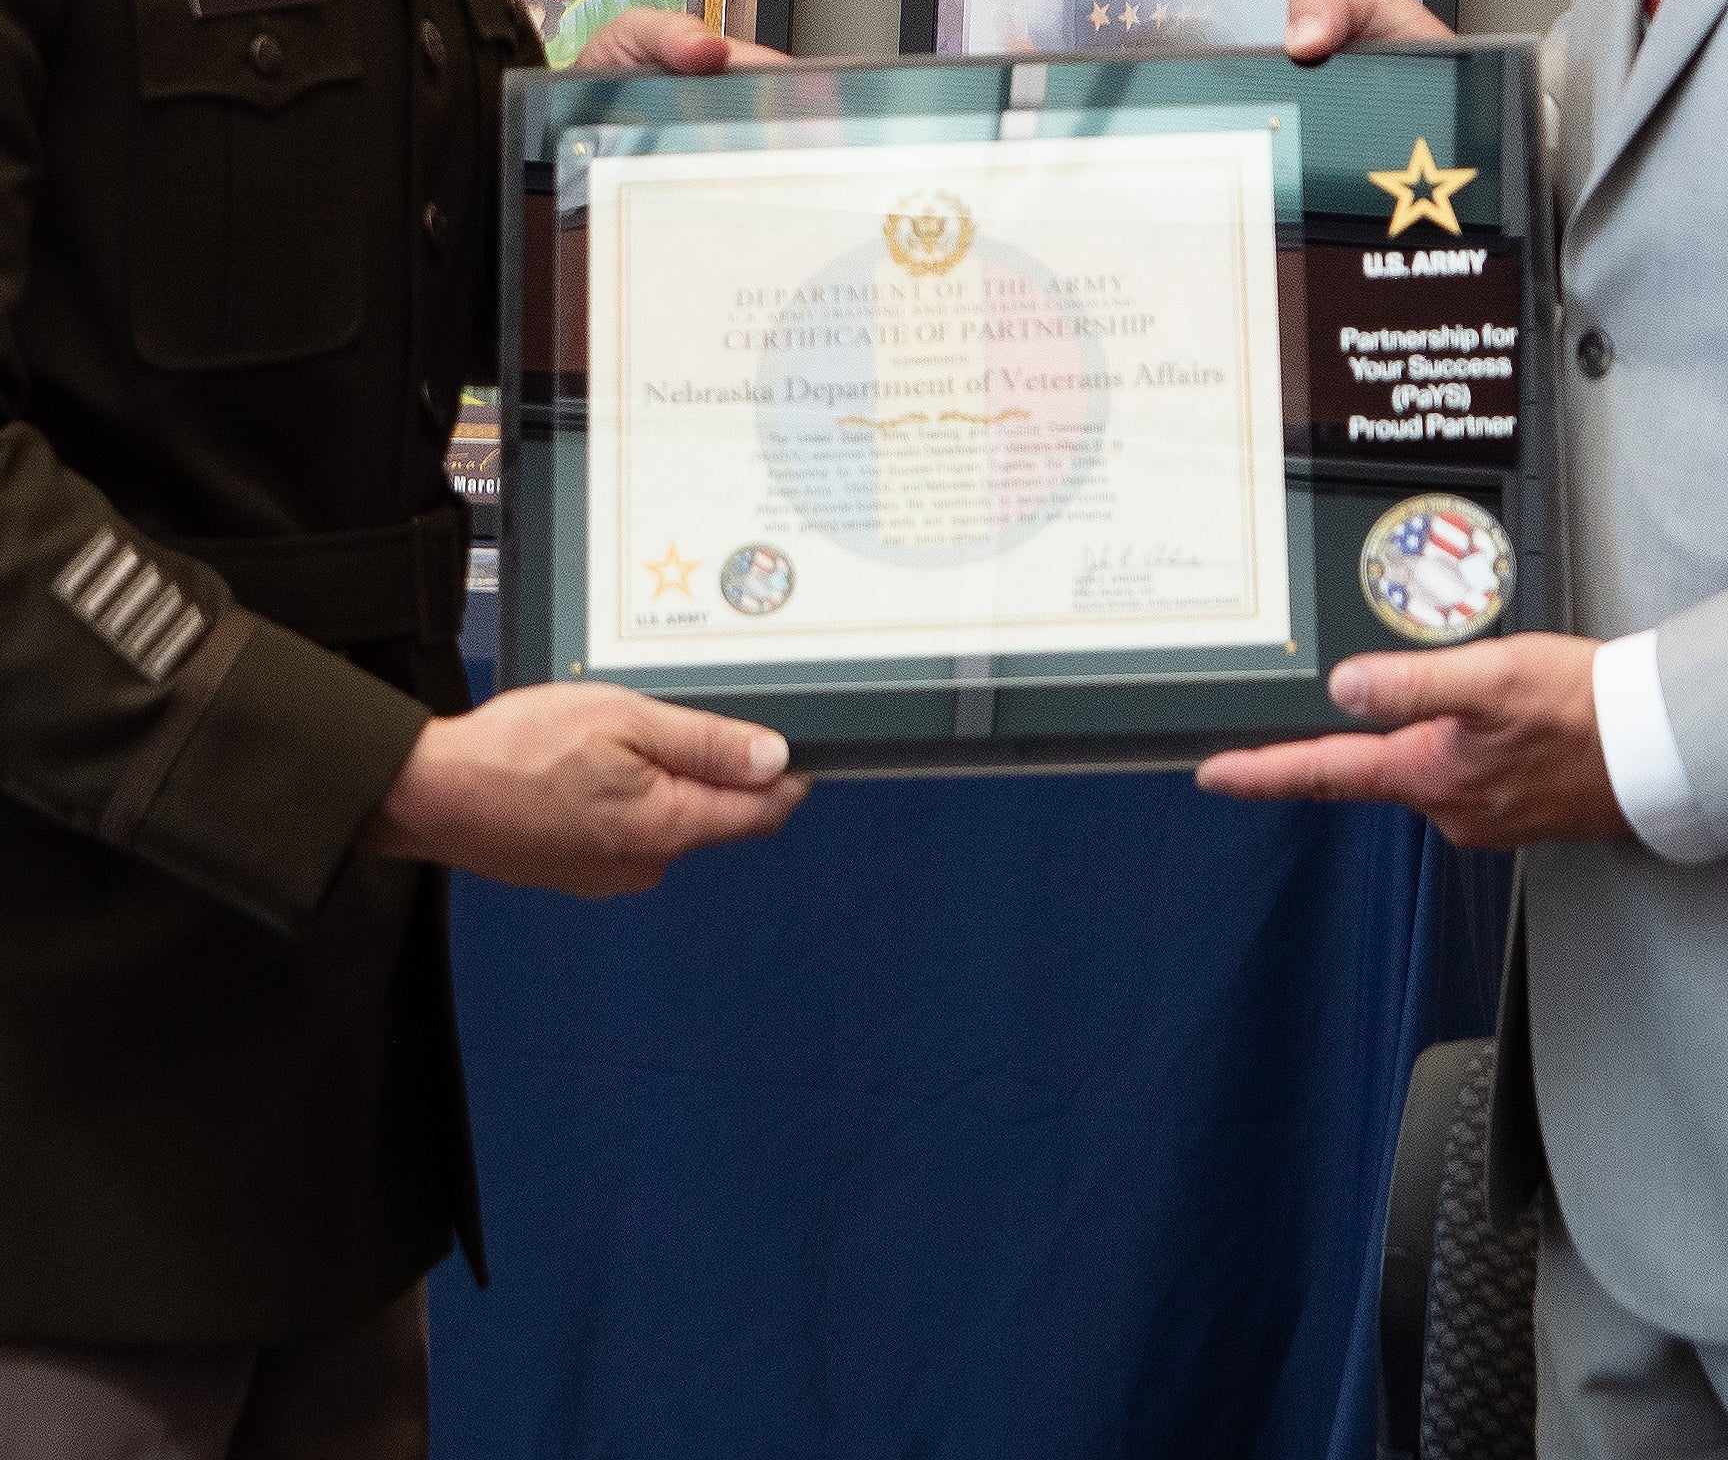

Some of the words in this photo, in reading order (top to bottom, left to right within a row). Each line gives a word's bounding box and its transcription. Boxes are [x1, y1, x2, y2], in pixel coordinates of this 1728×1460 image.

[1363, 250, 1410, 279] U.S.
[1411, 248, 1487, 277] ARMY
[734, 281, 923, 308] DEPARTMENT
[1047, 273, 1124, 295] ARMY
[722, 322, 908, 351] CERTIFICATE
[915, 319, 949, 343] OF
[960, 313, 1156, 343] PARTNERSHIP
[1340, 324, 1479, 353] Partnership
[1481, 322, 1519, 349] for
[644, 378, 775, 405] Nebraska
[781, 373, 955, 407] Department
[965, 368, 994, 393] of
[999, 367, 1123, 392] Veterans
[1134, 360, 1226, 387] Affairs
[1348, 356, 1406, 382] Your
[1407, 354, 1513, 380] Success
[1391, 383, 1471, 413] (PaYS)
[1349, 414, 1423, 442] Proud
[1425, 413, 1518, 439] Partner
